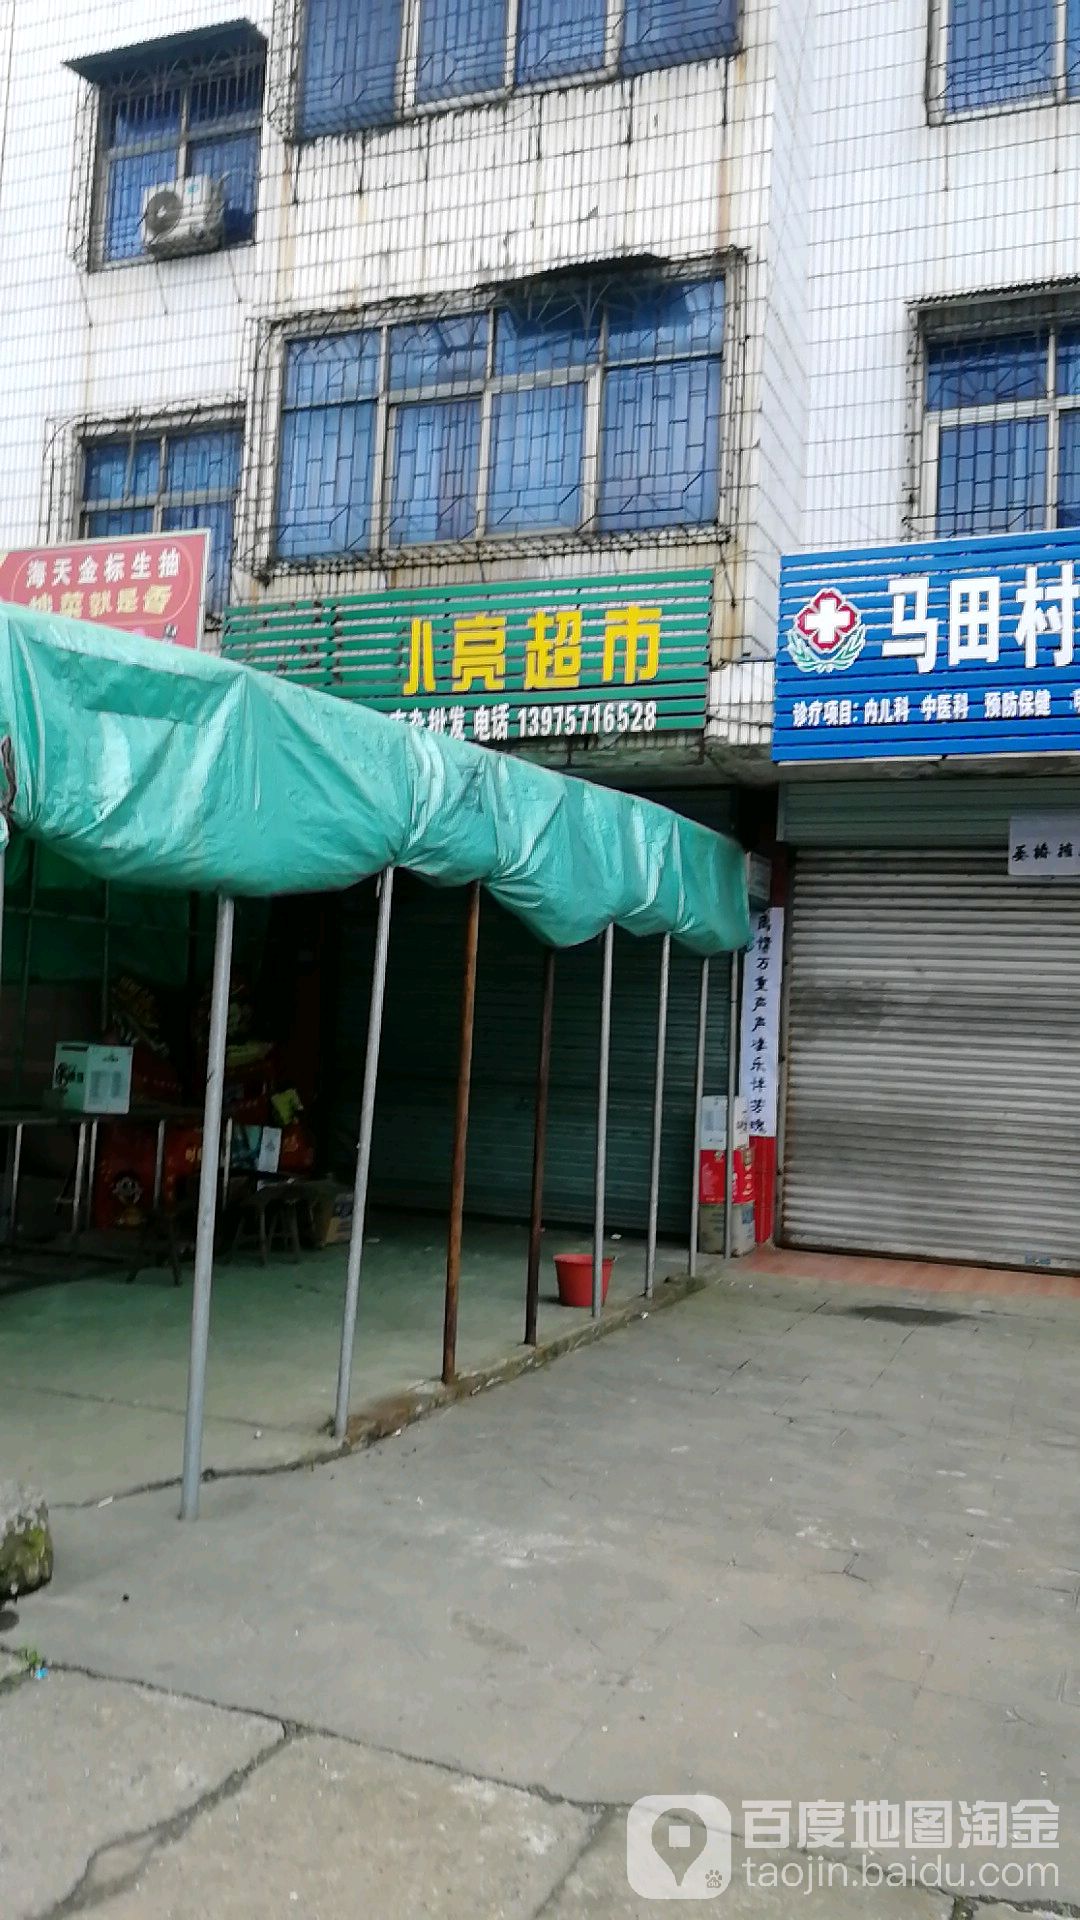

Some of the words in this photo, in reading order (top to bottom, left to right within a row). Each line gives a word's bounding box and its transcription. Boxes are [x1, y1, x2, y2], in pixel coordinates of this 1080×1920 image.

[26, 547, 180, 588] 海天金标生抽
[882, 563, 1080, 673] 马田村
[403, 604, 662, 695] 小亮超市
[474, 702, 509, 741] 电话
[518, 700, 657, 738] 13975716528
[921, 692, 968, 721] 中医科
[985, 688, 1051, 718] 预防保健
